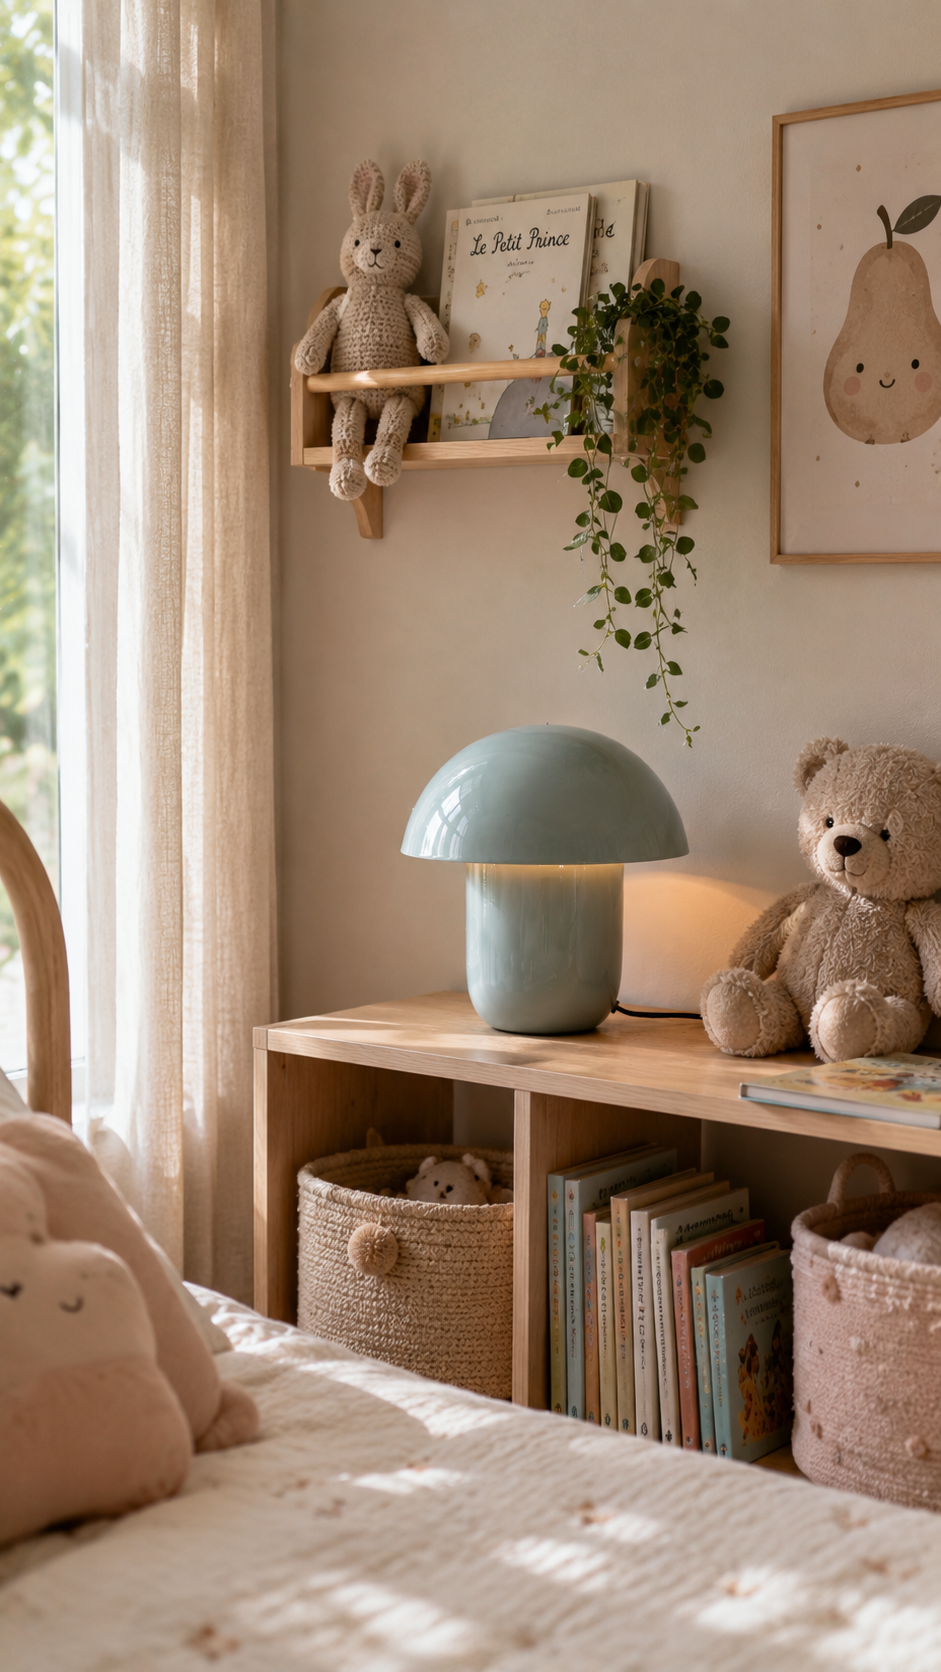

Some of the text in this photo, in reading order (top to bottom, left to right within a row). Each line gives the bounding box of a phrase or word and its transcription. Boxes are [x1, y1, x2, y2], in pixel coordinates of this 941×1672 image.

[470, 233, 487, 257] Le
[491, 231, 522, 255] Petit
[526, 227, 570, 250] Prince
